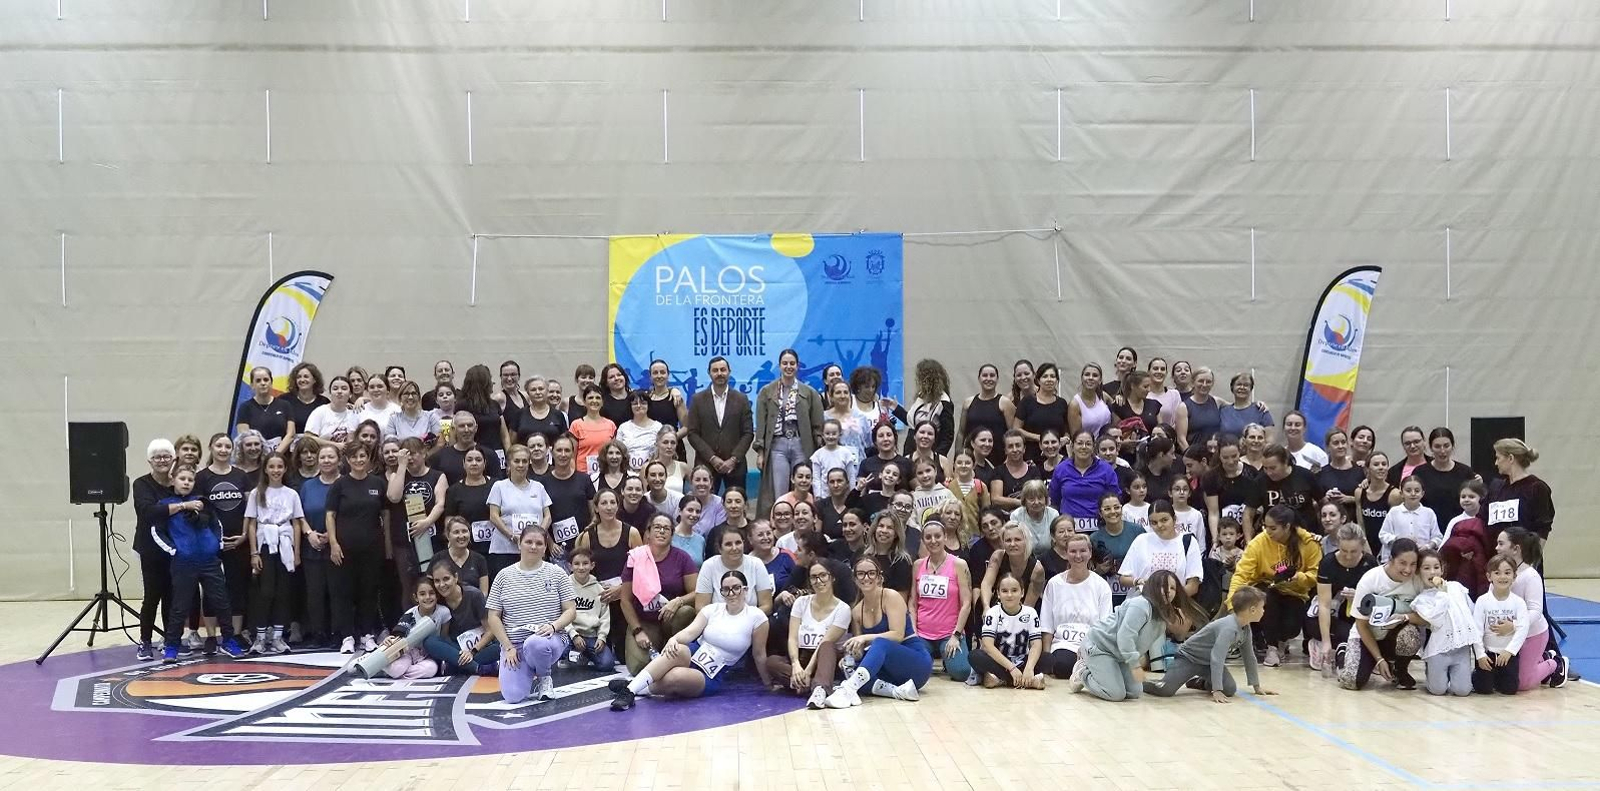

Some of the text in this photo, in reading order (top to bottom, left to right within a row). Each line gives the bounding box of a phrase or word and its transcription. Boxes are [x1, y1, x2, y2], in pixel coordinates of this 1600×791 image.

[656, 265, 766, 294] PALOS
[656, 294, 765, 306] DE LA FRONTERA
[694, 317, 766, 346] ES DEPORTE
[209, 490, 243, 501] adidas
[1493, 507, 1515, 520] 118
[477, 527, 496, 540] 03
[557, 524, 577, 539] 066
[923, 583, 946, 596] 075
[698, 651, 718, 674] 074
